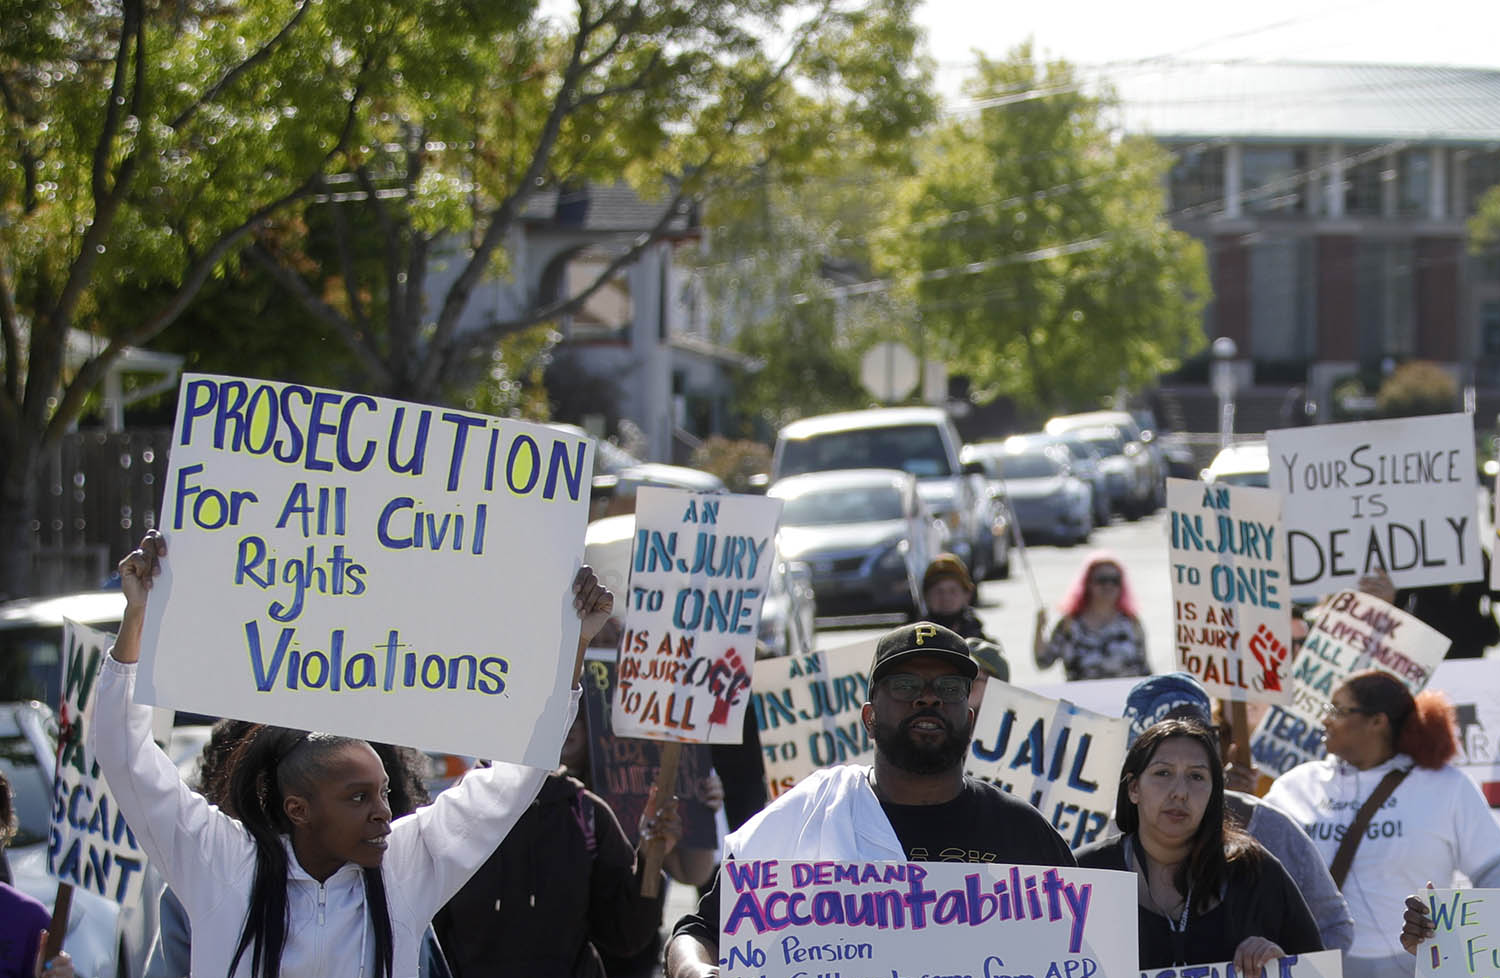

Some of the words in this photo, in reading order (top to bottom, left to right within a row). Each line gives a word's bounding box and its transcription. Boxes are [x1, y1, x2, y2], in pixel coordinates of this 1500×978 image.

[179, 379, 588, 502] PROSECUTION
[1350, 444, 1462, 486] SILENCE
[172, 464, 258, 531] For
[276, 483, 346, 536] All
[377, 497, 487, 555] Civil
[683, 500, 719, 525] AN
[1202, 487, 1229, 510] AN
[1351, 494, 1388, 518] IS
[635, 529, 769, 580] INJURY
[1170, 511, 1274, 561] INJURY
[1287, 516, 1469, 586] DEADLY
[234, 536, 367, 621] Rights
[1174, 564, 1200, 585] TO
[1212, 564, 1280, 609] ONE
[633, 587, 664, 612] TO
[673, 588, 760, 634] ONE
[1176, 602, 1197, 621] IS
[1206, 606, 1234, 628] AN
[623, 629, 650, 655] IS
[656, 632, 695, 660] AN
[915, 622, 937, 646] P
[1177, 623, 1240, 650] INJURY
[1306, 634, 1343, 666] ALL
[1318, 614, 1373, 652] LIVES
[66, 632, 101, 712] W
[244, 621, 510, 697] Violations
[789, 652, 821, 679] AN
[640, 692, 697, 731] ALL
[763, 740, 798, 763] TO
[972, 709, 1099, 794] JAIL
[1367, 820, 1403, 840] GO!
[726, 860, 778, 893] WE
[791, 863, 928, 889] DEMAND
[1429, 892, 1485, 932] WE
[781, 936, 873, 965] Pension
